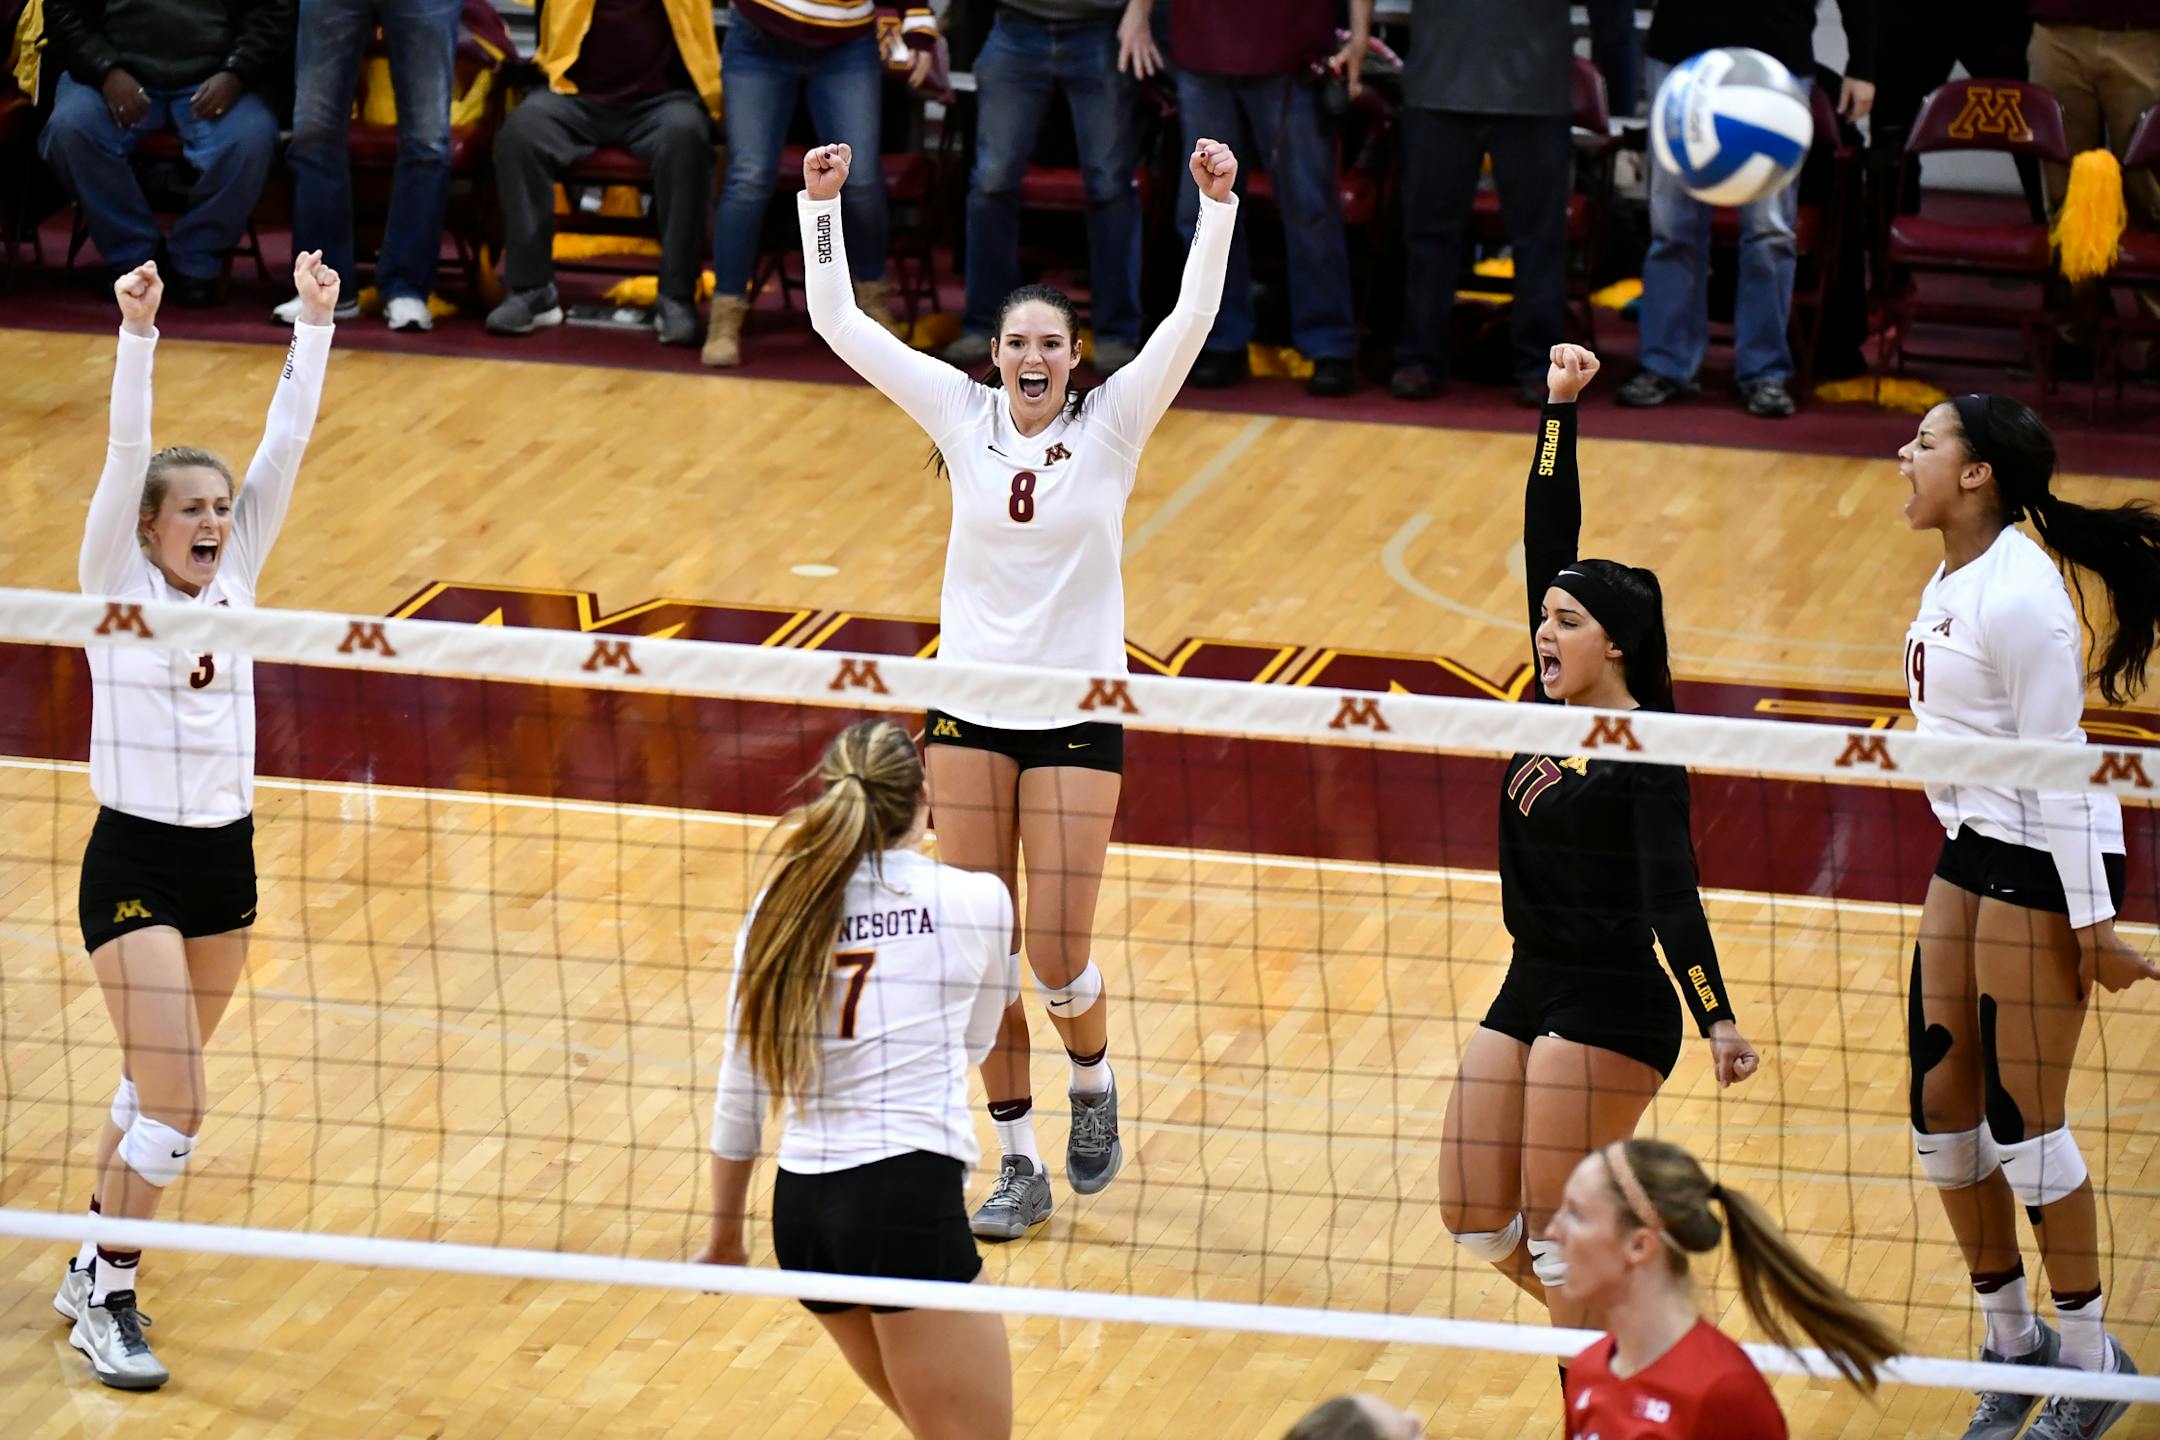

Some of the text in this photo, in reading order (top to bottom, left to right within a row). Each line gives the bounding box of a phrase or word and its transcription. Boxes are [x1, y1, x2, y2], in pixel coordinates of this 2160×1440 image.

[1948, 86, 2034, 142] M
[817, 214, 832, 264] GOPHERS
[1538, 419, 1561, 477] GOPHERS
[1009, 470, 1037, 524] 8
[95, 603, 2153, 789] M M M M M M M M M
[188, 652, 216, 690] 3
[1507, 752, 1563, 817] 17
[832, 949, 877, 1040] 7
[1687, 964, 1719, 1013] GOLDEN
